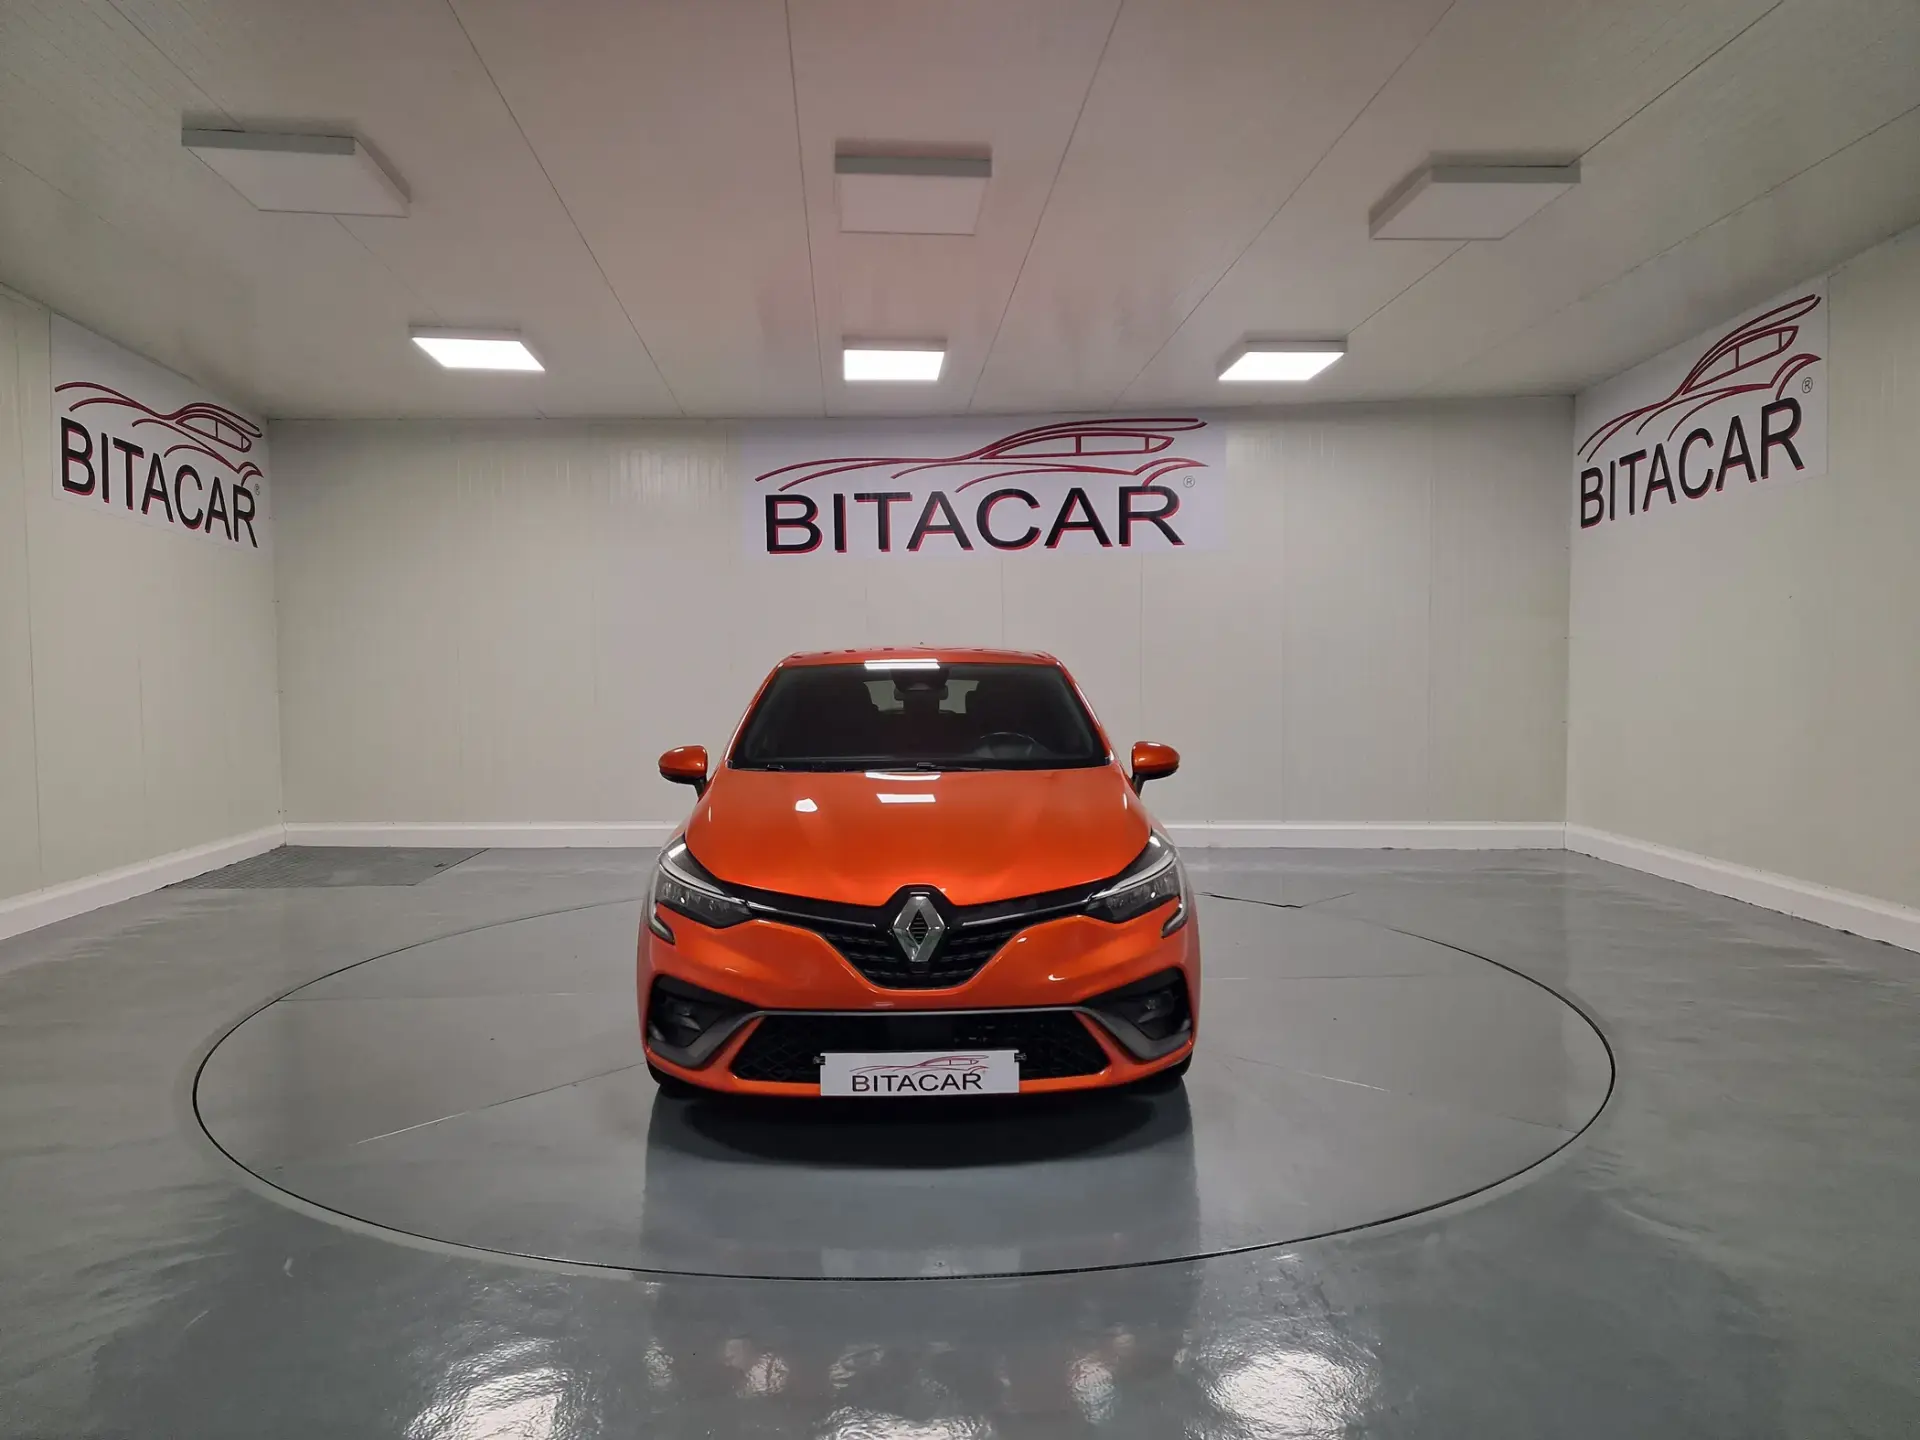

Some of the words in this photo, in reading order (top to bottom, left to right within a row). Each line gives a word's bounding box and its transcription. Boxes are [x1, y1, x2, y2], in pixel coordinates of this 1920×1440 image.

[61, 416, 259, 548] BITACAR
[1580, 397, 1805, 529] BITACAR
[765, 485, 1185, 554] BITACAR
[852, 1073, 983, 1092] BITACAR
